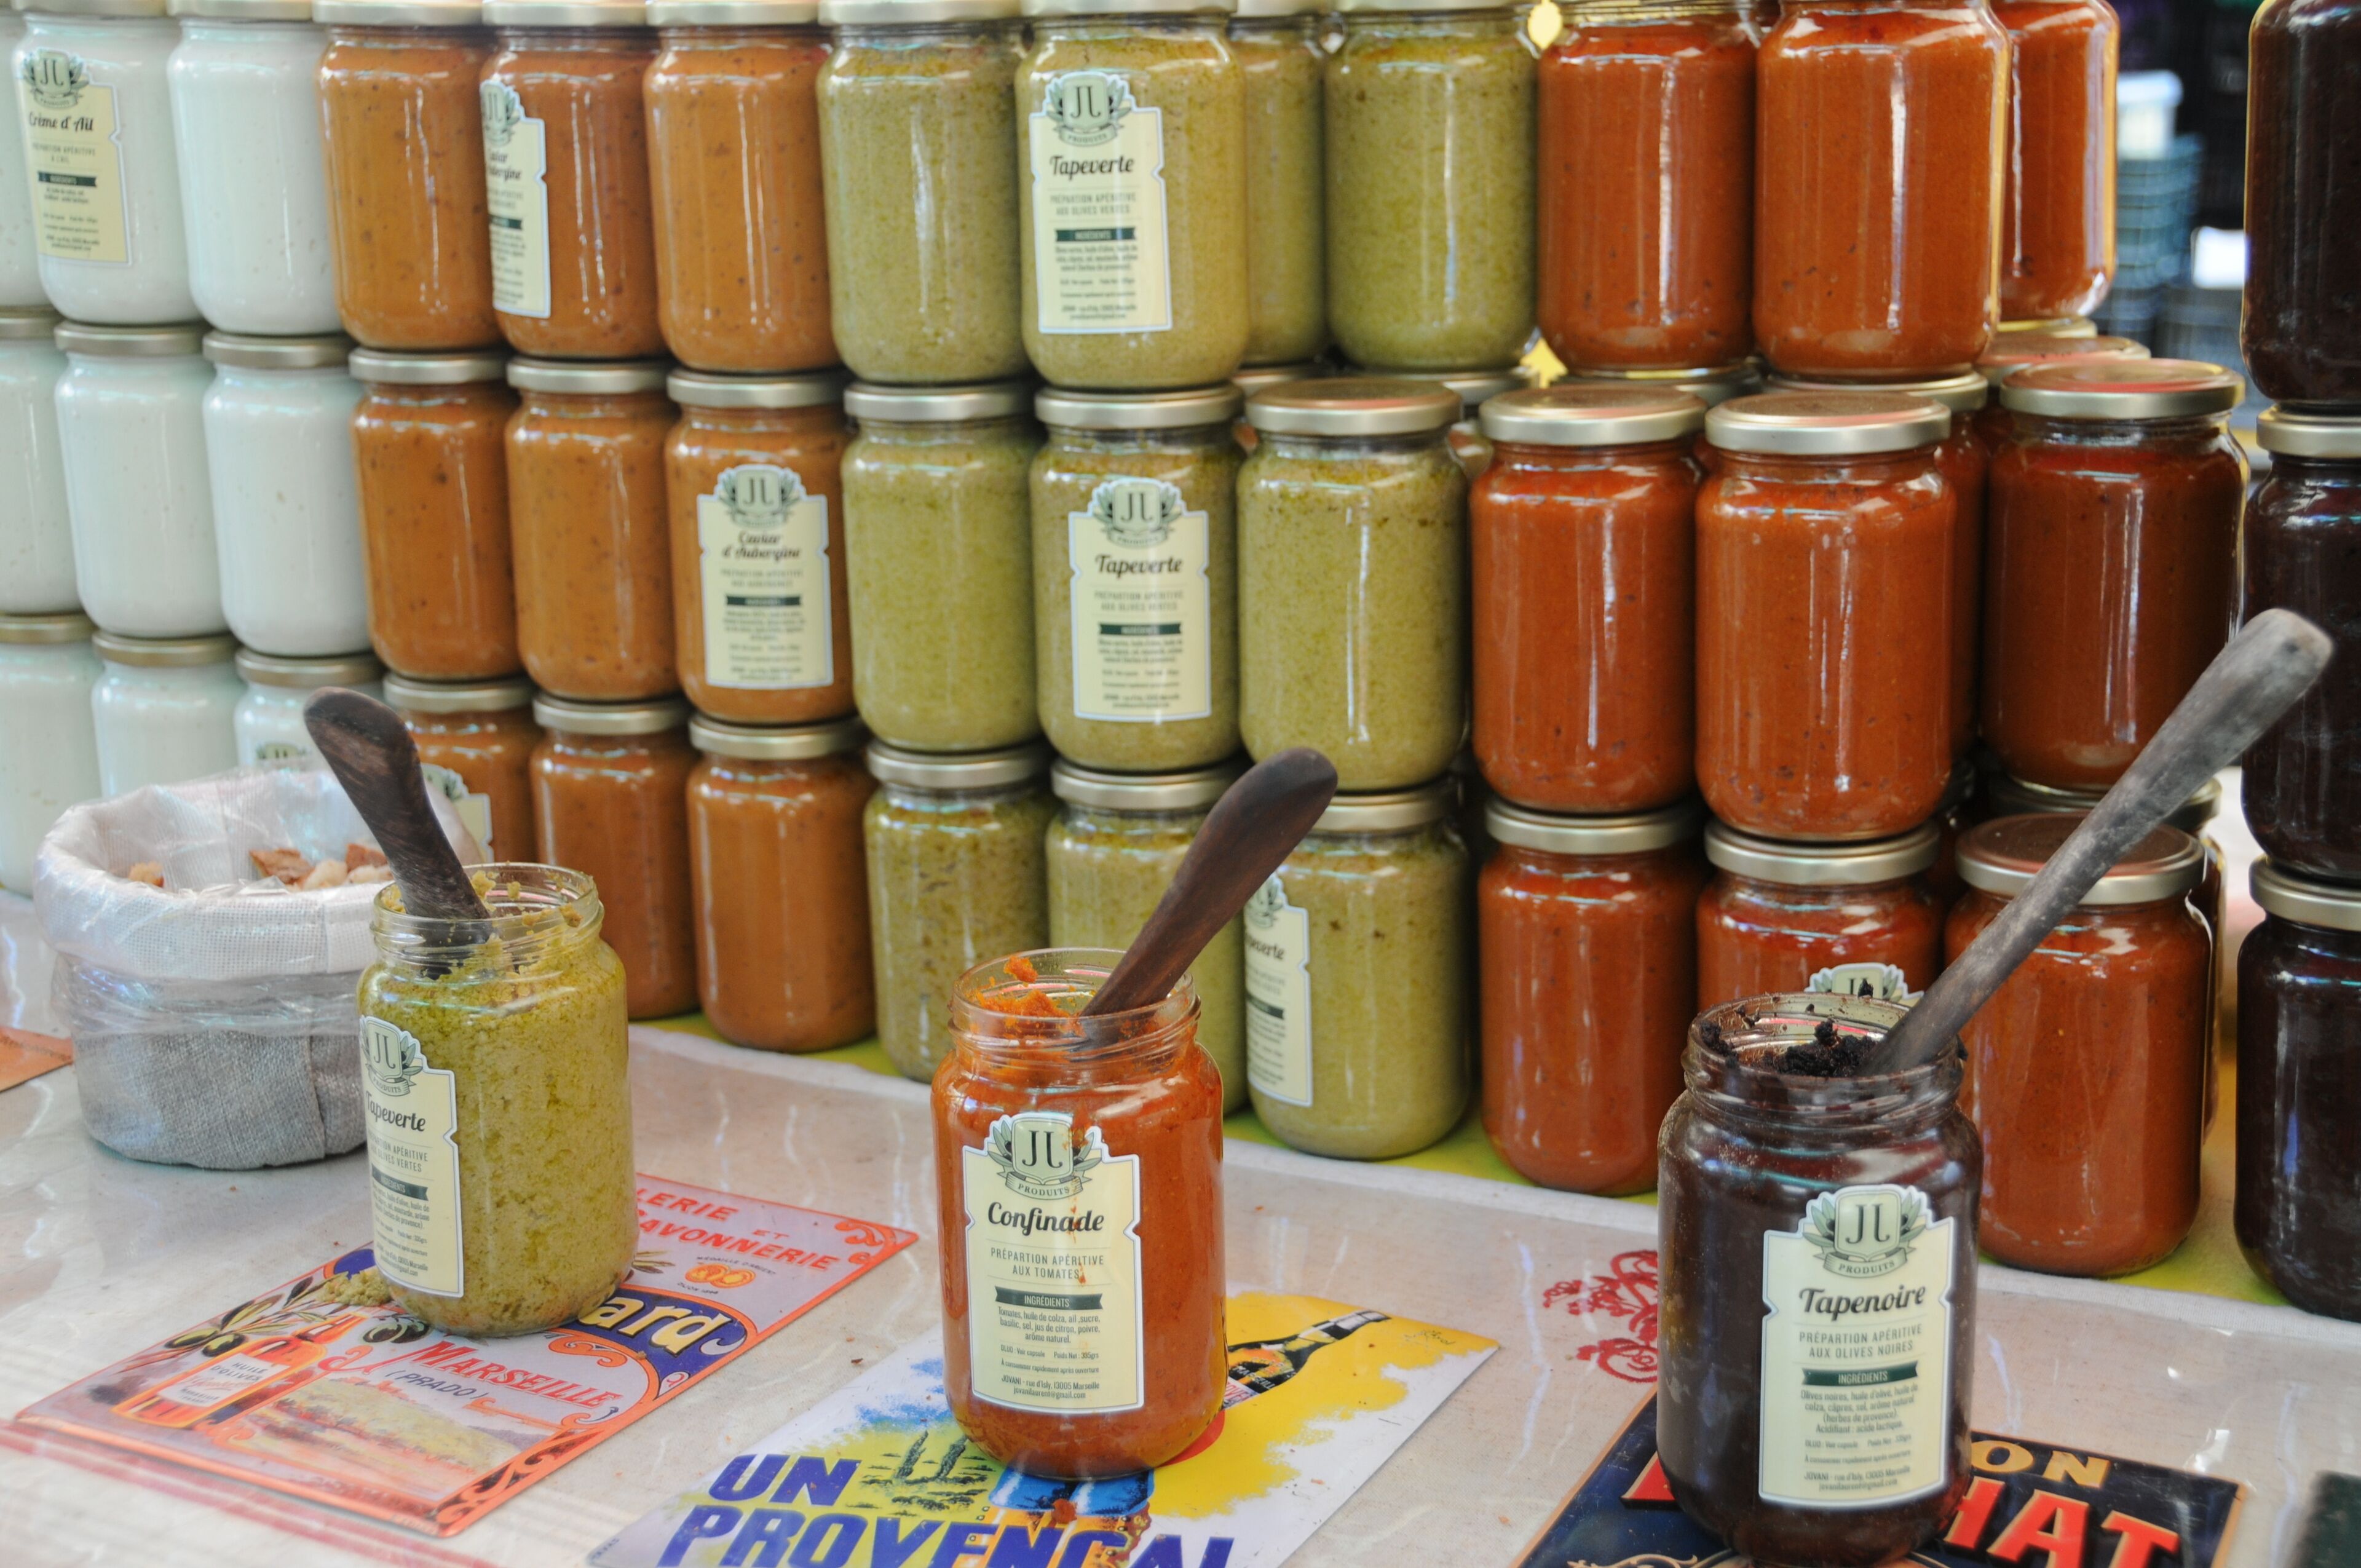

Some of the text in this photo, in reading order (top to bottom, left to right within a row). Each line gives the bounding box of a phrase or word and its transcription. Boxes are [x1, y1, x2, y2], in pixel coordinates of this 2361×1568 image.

[1049, 154, 1134, 182] Tapeverte
[1094, 553, 1183, 579] Tapeverte
[373, 1077, 402, 1093] PRODUITS
[365, 1090, 427, 1133] Tapeverte
[394, 1145, 429, 1162] APÉRITIVE
[397, 1157, 422, 1173] VERTES
[1018, 1184, 1070, 1197] PRODUITS
[987, 1202, 1105, 1237] Confinade
[991, 1247, 1104, 1265] PRÉPARTION APÉRITIVE
[1012, 1264, 1080, 1279] AUX TOMATES
[1838, 1259, 1896, 1275] PRODUITS
[1024, 1294, 1070, 1308] INGRÉDIENTS
[1798, 1283, 1926, 1321] Tapenoire
[998, 1305, 1022, 1319] Tomates,
[1023, 1309, 1038, 1321] huile
[1038, 1312, 1047, 1321] de
[1048, 1313, 1067, 1323] colza,
[1068, 1313, 1077, 1323] ail
[1000, 1316, 1021, 1329] basilic,
[1034, 1322, 1045, 1332] jus
[1045, 1323, 1054, 1332] de
[1054, 1324, 1077, 1334] citron,
[1077, 1324, 1101, 1335] poivre,
[1798, 1323, 1923, 1344] PRÉPARTION APÉRITIVE
[1024, 1331, 1071, 1344] arôme naturel.
[1808, 1340, 1914, 1359] AUX OLIVES NOIRES
[210, 1364, 263, 1382] D'OLIVES
[231, 1361, 269, 1374] HUILE
[384, 1369, 489, 1400] (PRADO)
[1000, 1374, 1022, 1385] JOVANI
[1053, 1381, 1072, 1390] 13005
[1072, 1381, 1100, 1390] Marseille
[708, 1453, 863, 1507] UN
